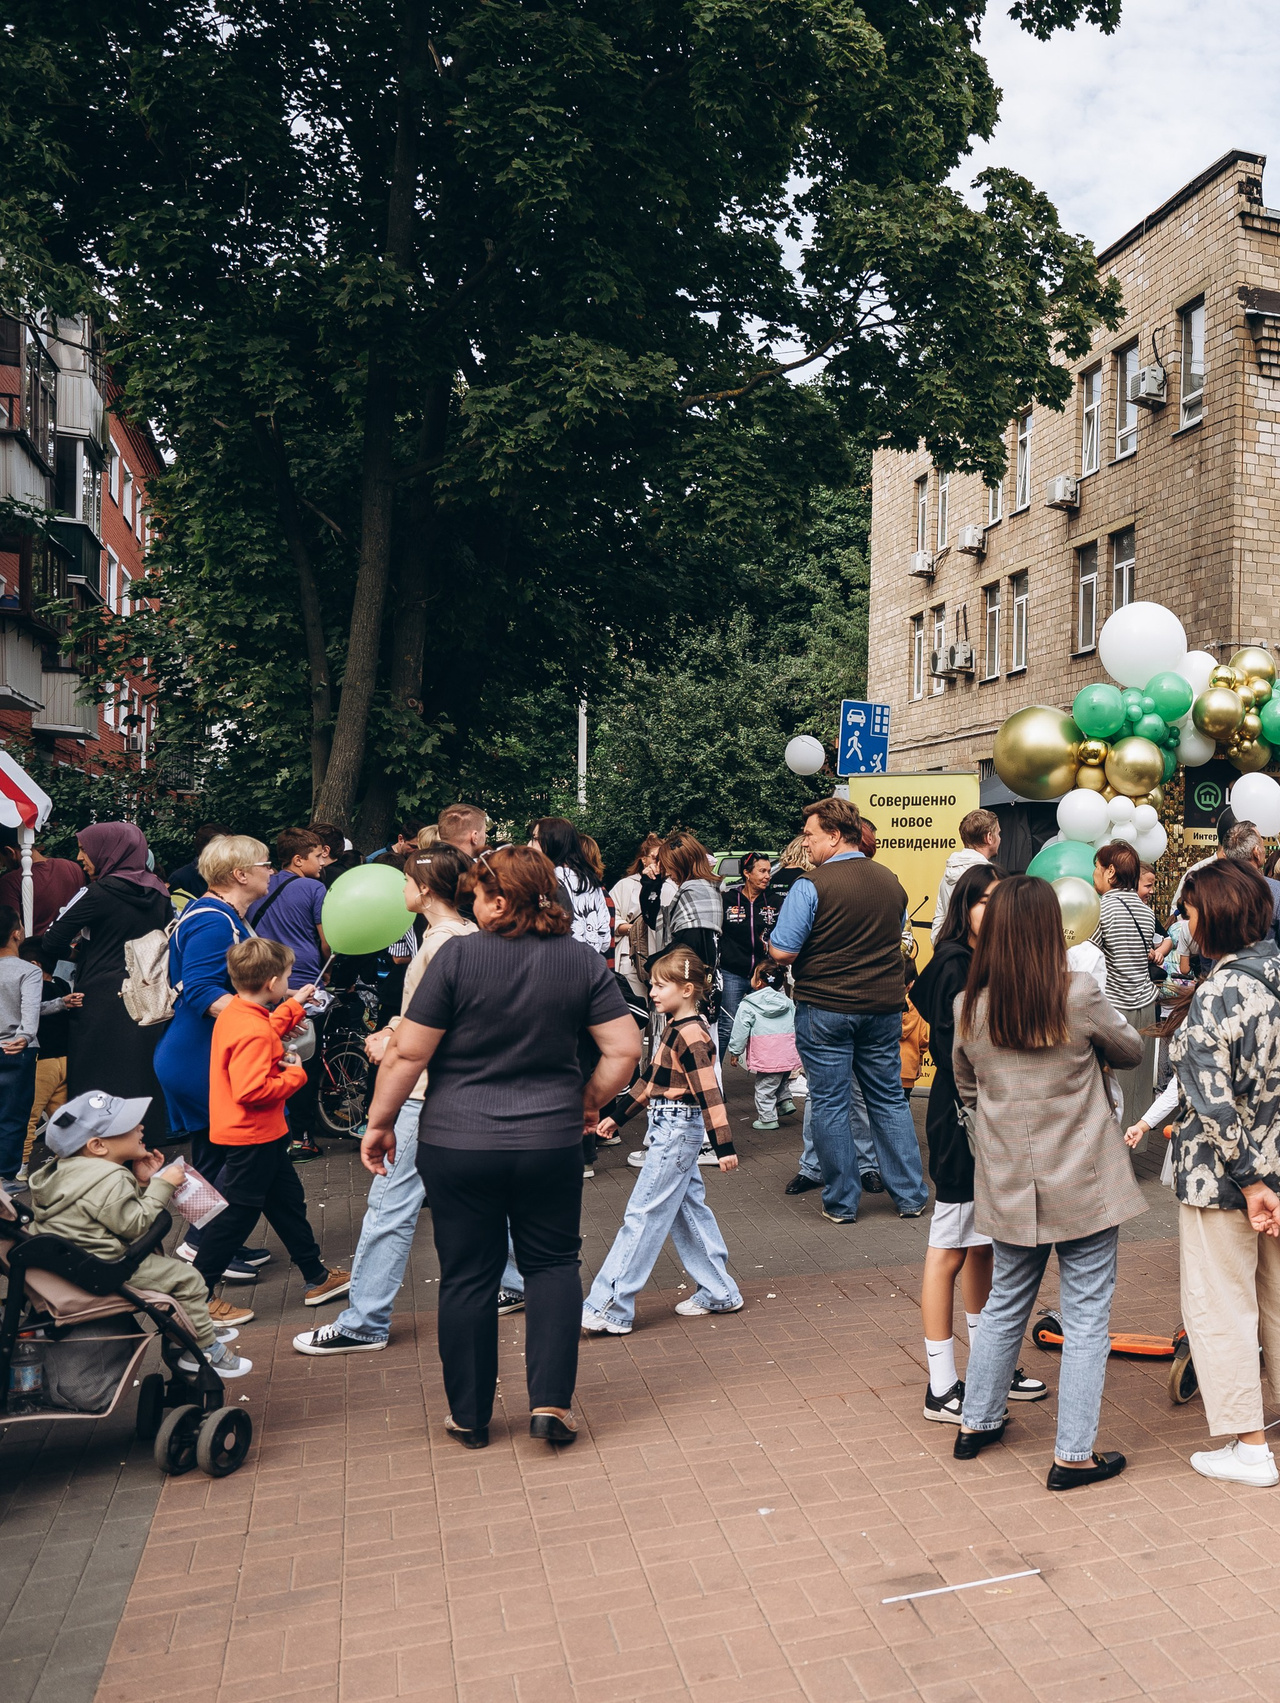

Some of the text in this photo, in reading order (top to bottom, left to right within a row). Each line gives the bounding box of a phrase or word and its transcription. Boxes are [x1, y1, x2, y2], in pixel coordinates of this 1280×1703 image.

[869, 793, 956, 810] Совершенно
[891, 816, 933, 828] новое
[1193, 832, 1218, 842] Интер
[875, 837, 956, 852] елевидение
